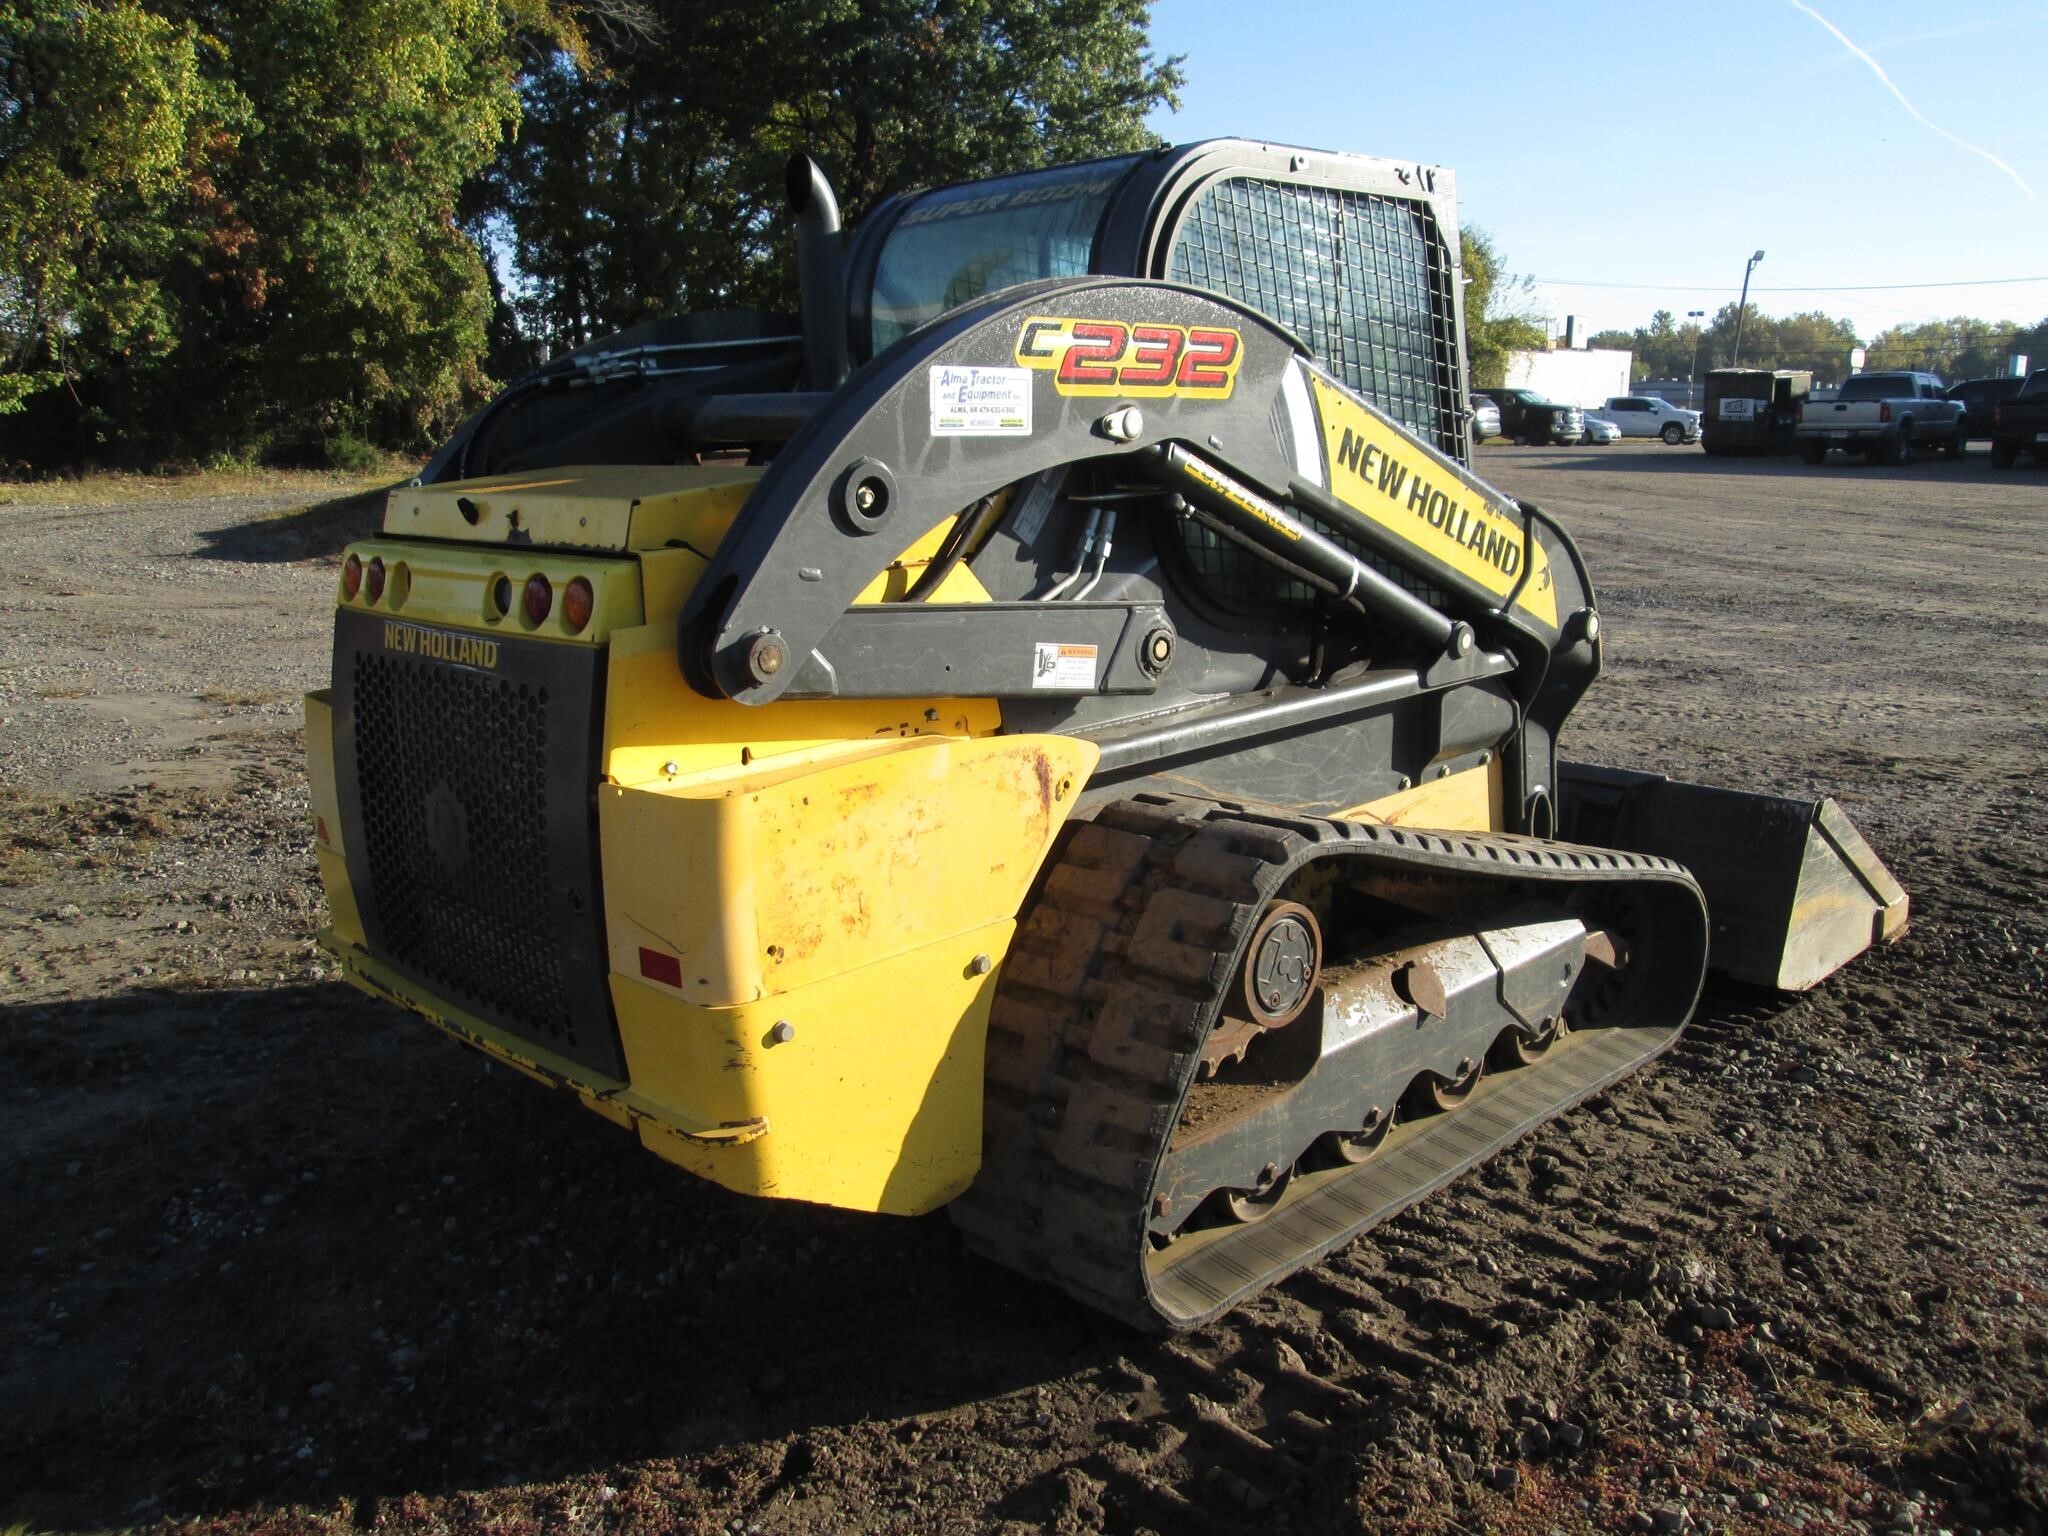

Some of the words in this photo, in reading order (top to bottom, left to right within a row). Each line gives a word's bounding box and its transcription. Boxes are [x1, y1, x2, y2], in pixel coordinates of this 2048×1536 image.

[902, 194, 1009, 226] SUPER
[1018, 320, 1239, 391] C232
[940, 369, 968, 386] Alma
[970, 369, 1007, 387] Tractor
[957, 385, 1012, 403] Equipment
[1336, 426, 1408, 501] NEW
[1406, 474, 1521, 578] HOLLAND
[384, 622, 417, 653] NEW
[419, 629, 498, 669] HOLLAND
